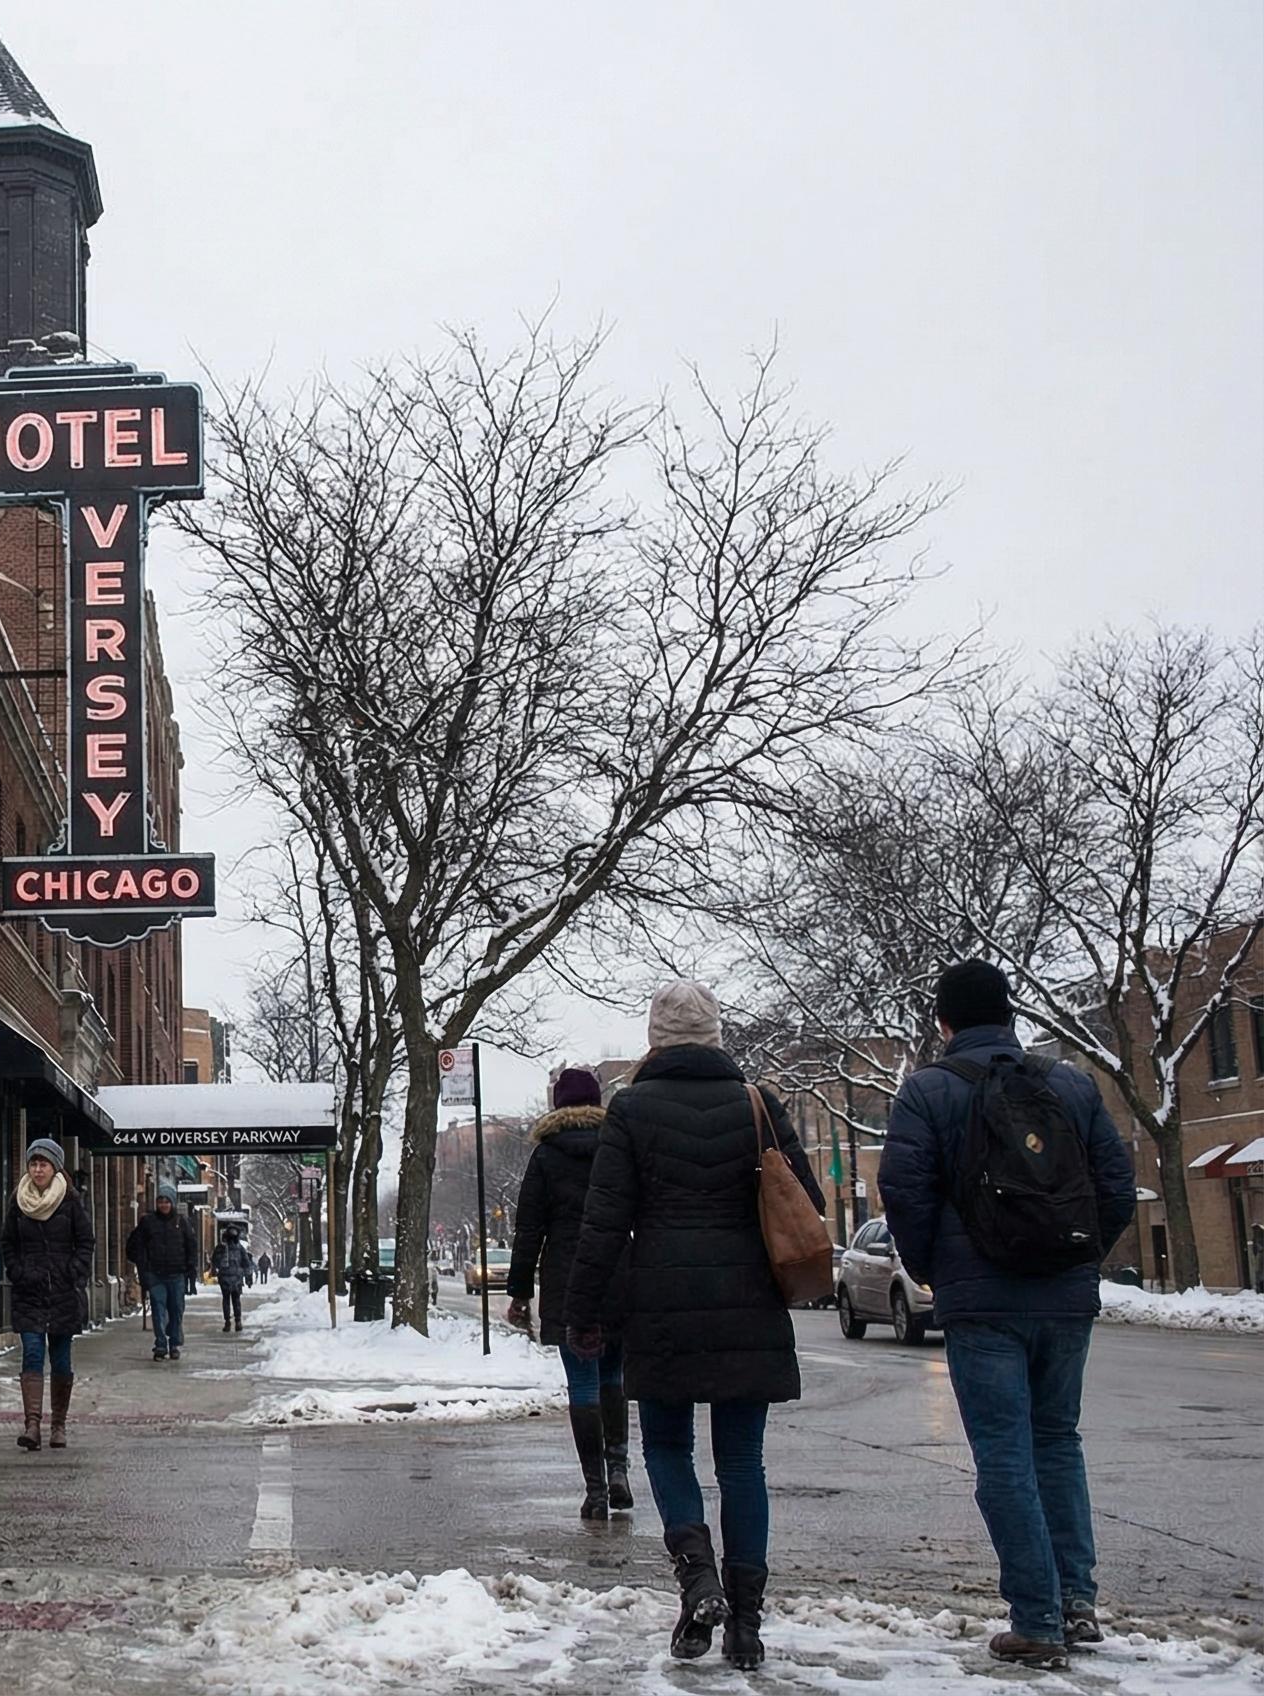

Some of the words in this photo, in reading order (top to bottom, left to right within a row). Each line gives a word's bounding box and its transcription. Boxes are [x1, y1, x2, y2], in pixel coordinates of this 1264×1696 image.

[79, 504, 132, 838] VERSEY
[14, 867, 201, 903] CHICAGO
[113, 1132, 138, 1145] 644
[141, 1132, 157, 1144] W
[160, 1131, 229, 1145] DIVERSEY
[232, 1129, 302, 1144] PARKWAY
